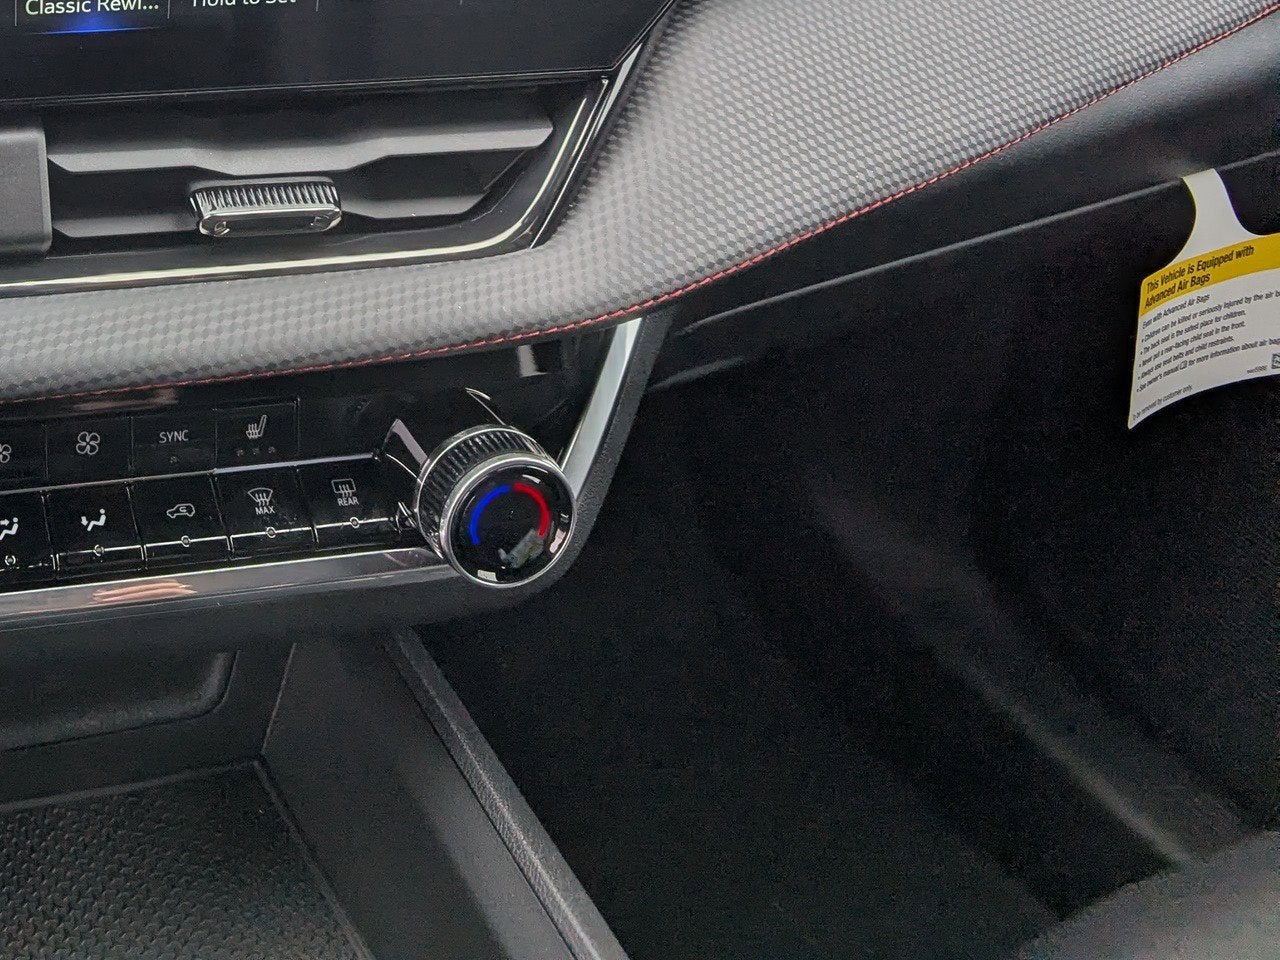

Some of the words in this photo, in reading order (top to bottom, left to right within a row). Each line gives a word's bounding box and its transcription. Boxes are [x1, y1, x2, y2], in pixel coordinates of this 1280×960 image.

[1146, 279, 1159, 294] This
[1160, 267, 1186, 285] Vehicle
[1187, 264, 1195, 274] is
[1197, 250, 1234, 272] Equipped
[1235, 245, 1255, 259] with
[1144, 285, 1176, 309] Advanced
[1177, 280, 1189, 292] Air
[1190, 273, 1211, 287] Bags
[158, 429, 189, 444] SYNC
[336, 494, 359, 507] REAR
[255, 504, 276, 516] MAX
